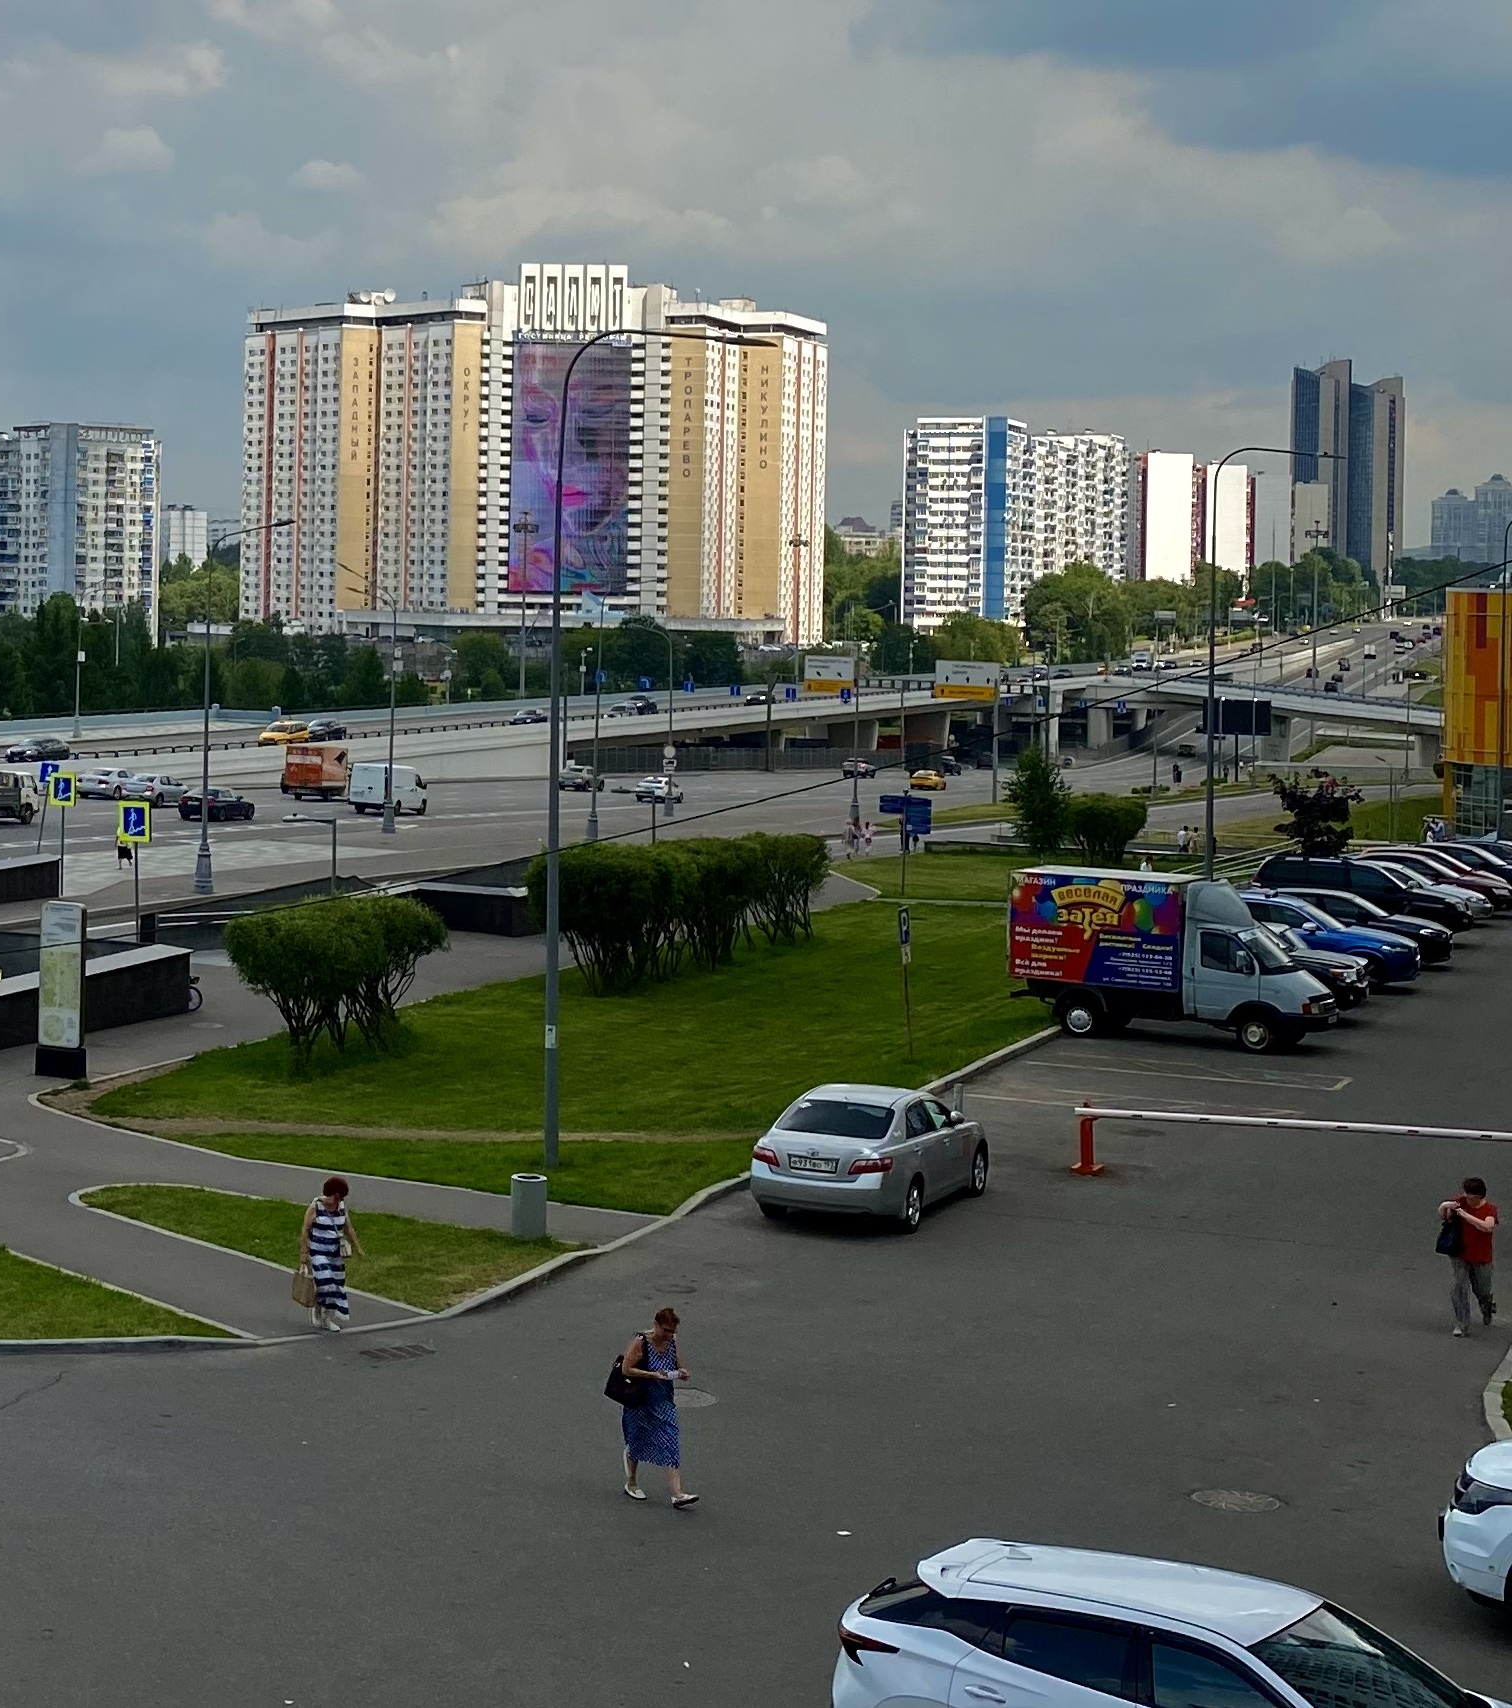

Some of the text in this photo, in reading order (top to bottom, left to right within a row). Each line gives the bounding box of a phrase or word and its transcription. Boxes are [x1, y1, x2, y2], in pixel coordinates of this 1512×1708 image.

[524, 278, 624, 323] САЛЮТ
[350, 357, 360, 461] ЗАПАДНЫЙ
[462, 366, 471, 432] ОКРУГ
[682, 357, 693, 478] ТРОПАРЕВО
[759, 364, 769, 470] НИКУЛИНО
